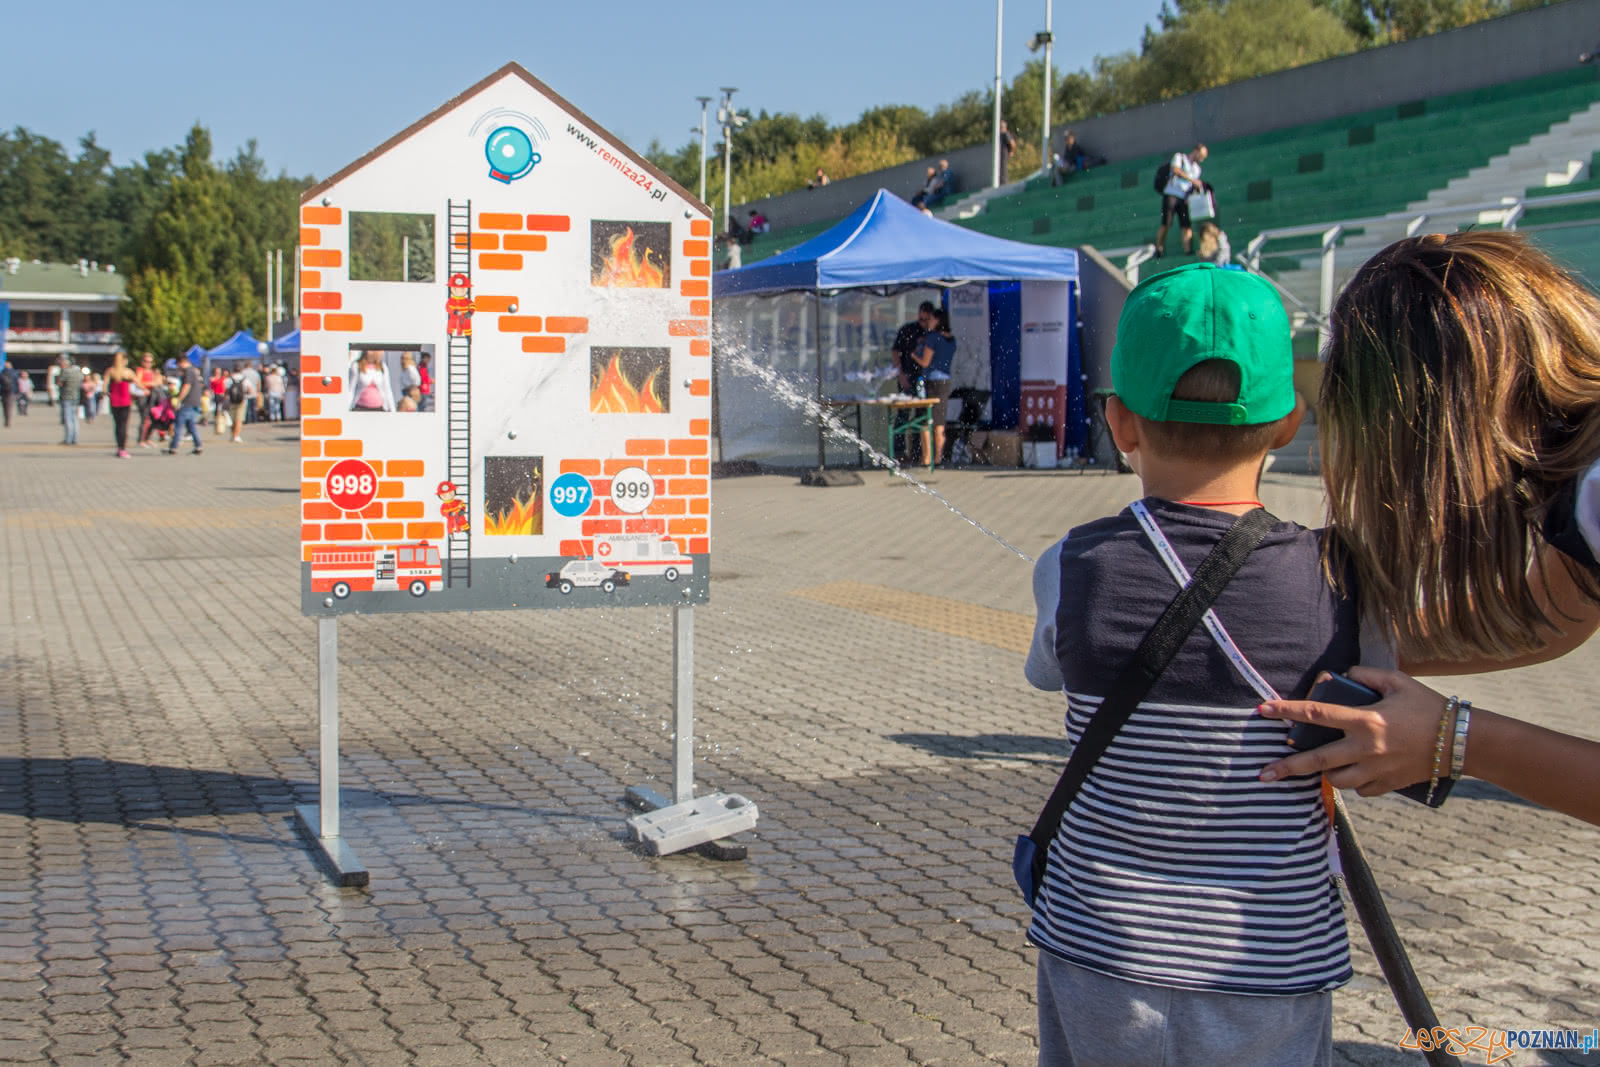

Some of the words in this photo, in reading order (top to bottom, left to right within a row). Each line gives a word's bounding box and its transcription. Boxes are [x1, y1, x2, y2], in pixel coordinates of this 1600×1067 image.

[567, 123, 668, 202] www.remiza24.pl
[331, 474, 373, 495] 998
[615, 481, 650, 499] 999
[553, 486, 589, 504] 997
